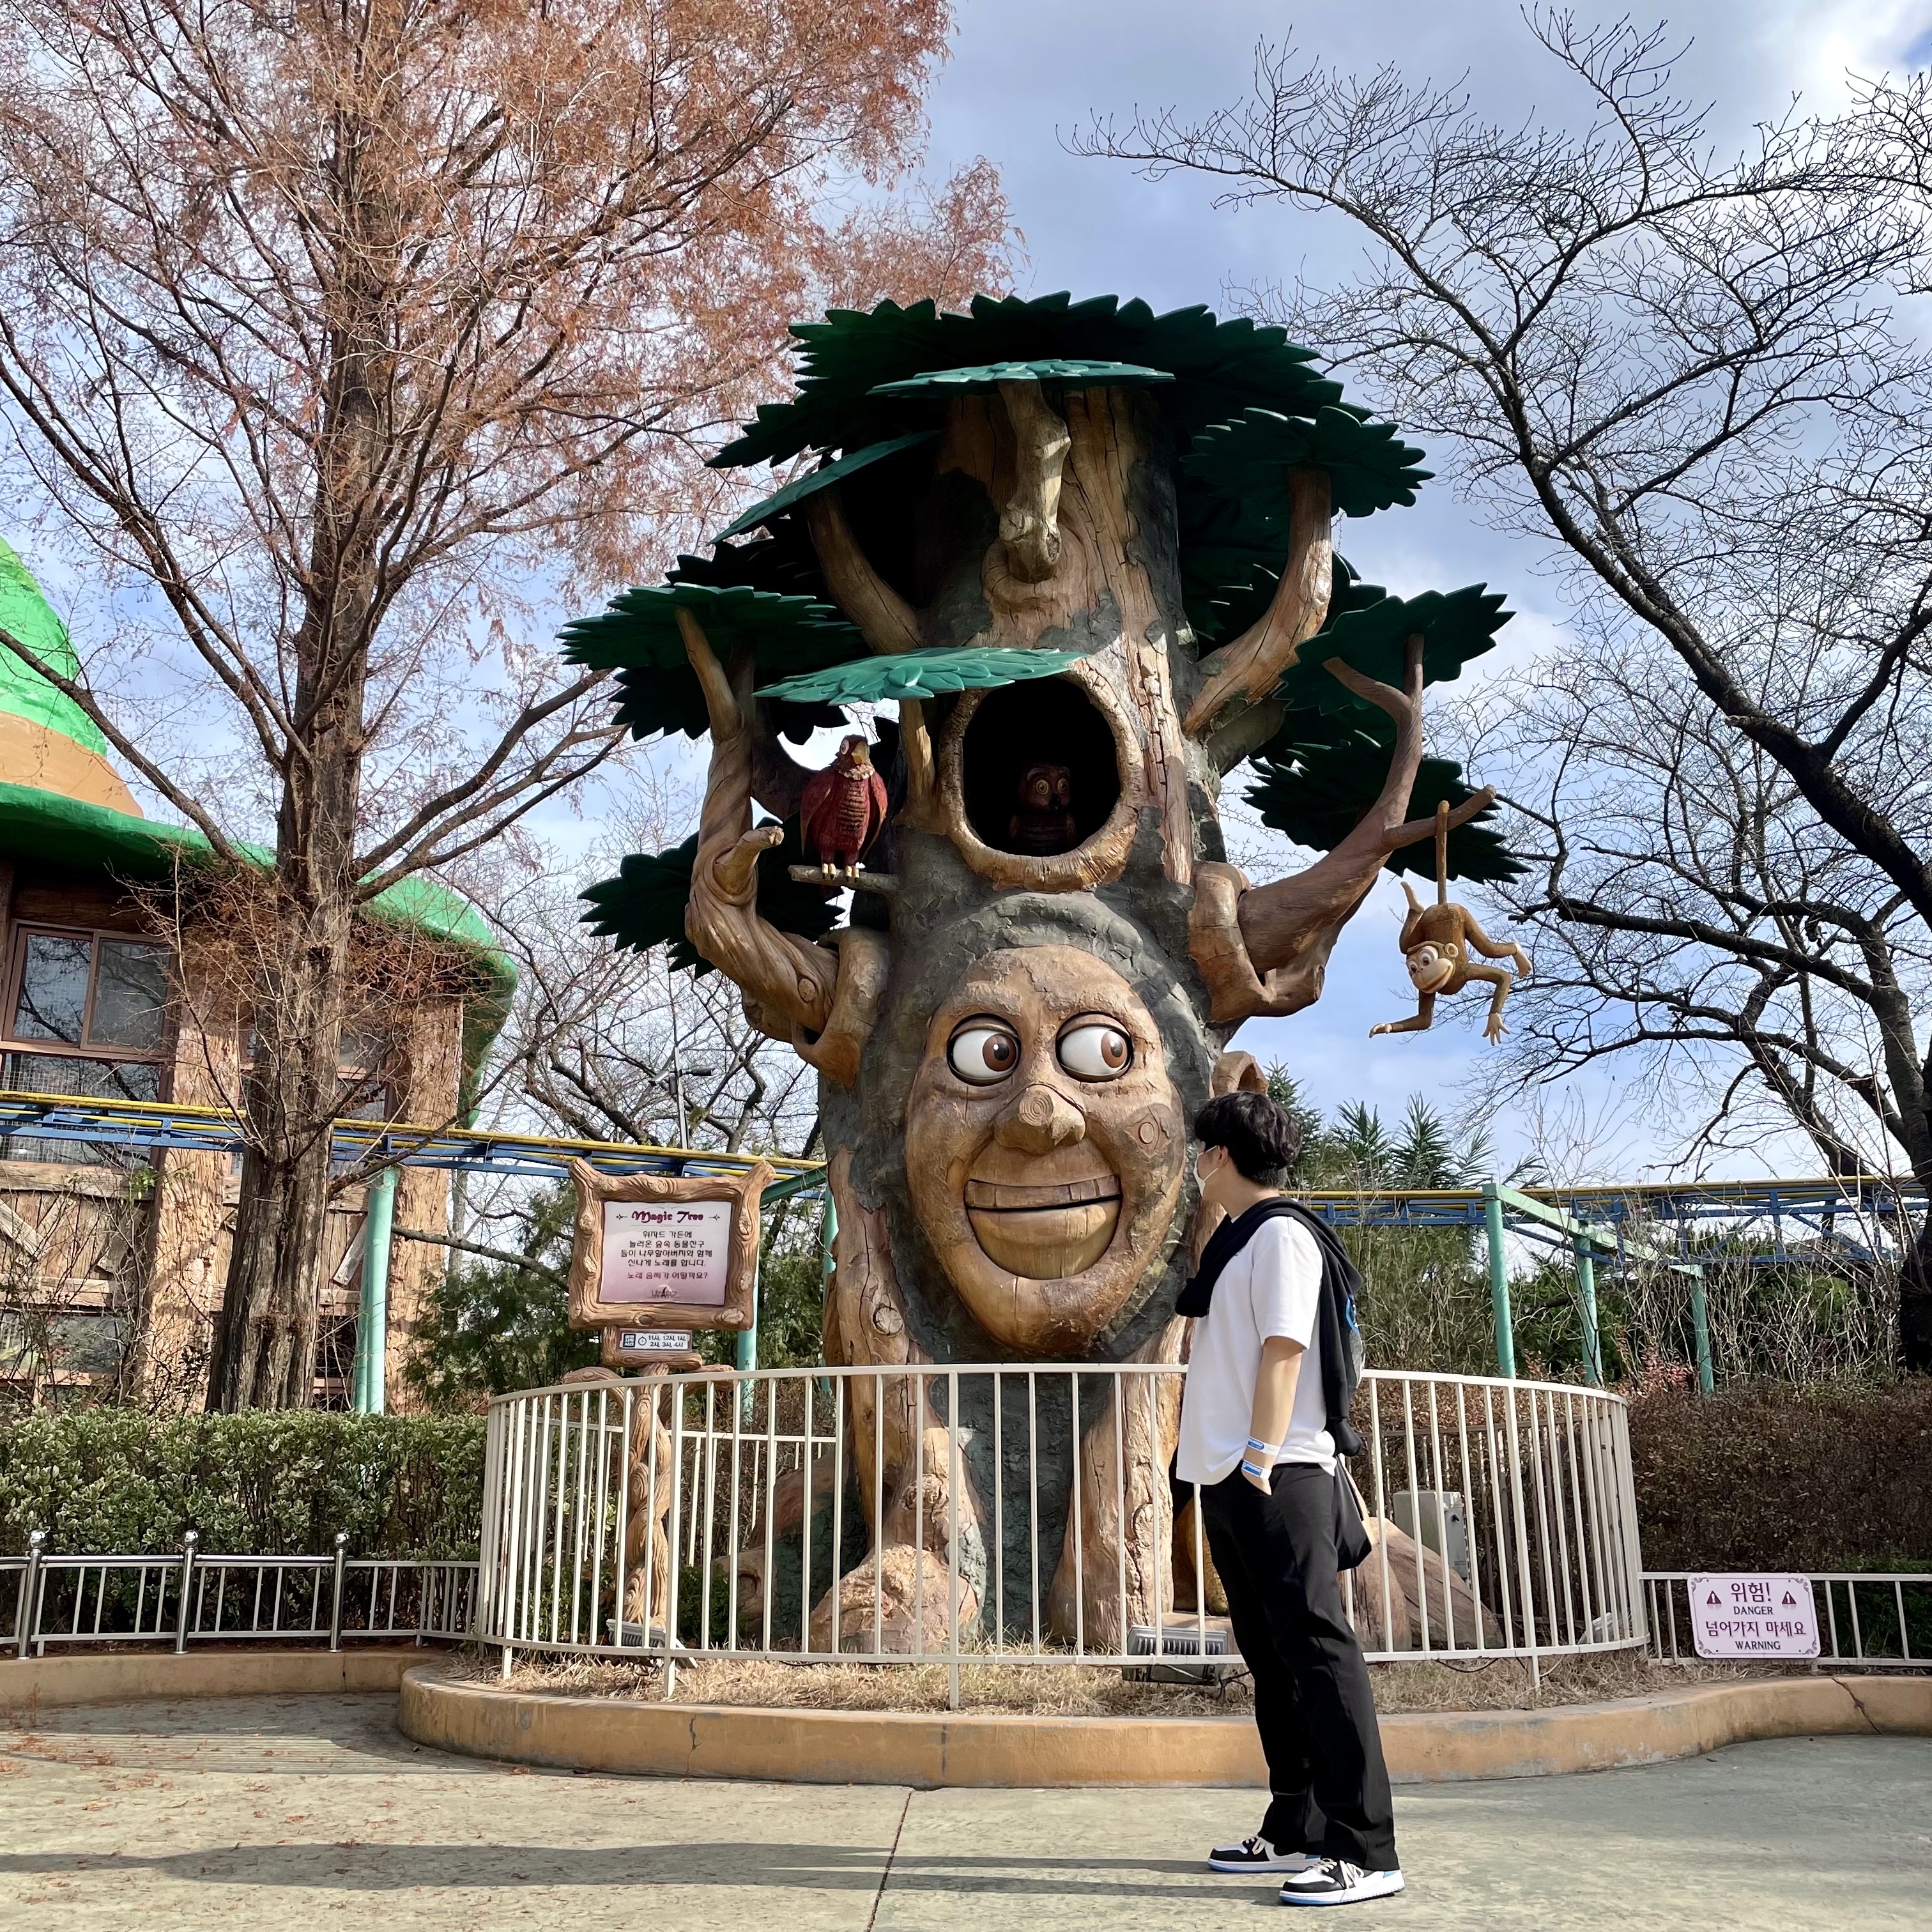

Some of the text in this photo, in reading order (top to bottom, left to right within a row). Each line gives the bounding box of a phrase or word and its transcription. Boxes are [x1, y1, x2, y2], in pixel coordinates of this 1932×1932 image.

[631, 1211, 703, 1223] Magic Tree
[643, 1230, 692, 1239] 위자드 가든에
[627, 1259, 707, 1267] 신나게 노래를 합니다.
[646, 1271, 670, 1280] 솜씨가
[672, 1271, 708, 1280] 어떨까요?
[1731, 1582, 1772, 1602] 위험!
[1733, 1606, 1774, 1615] DANGER
[1706, 1621, 1806, 1637] 넘어가지 마세요
[1735, 1641, 1781, 1650] WARNING
